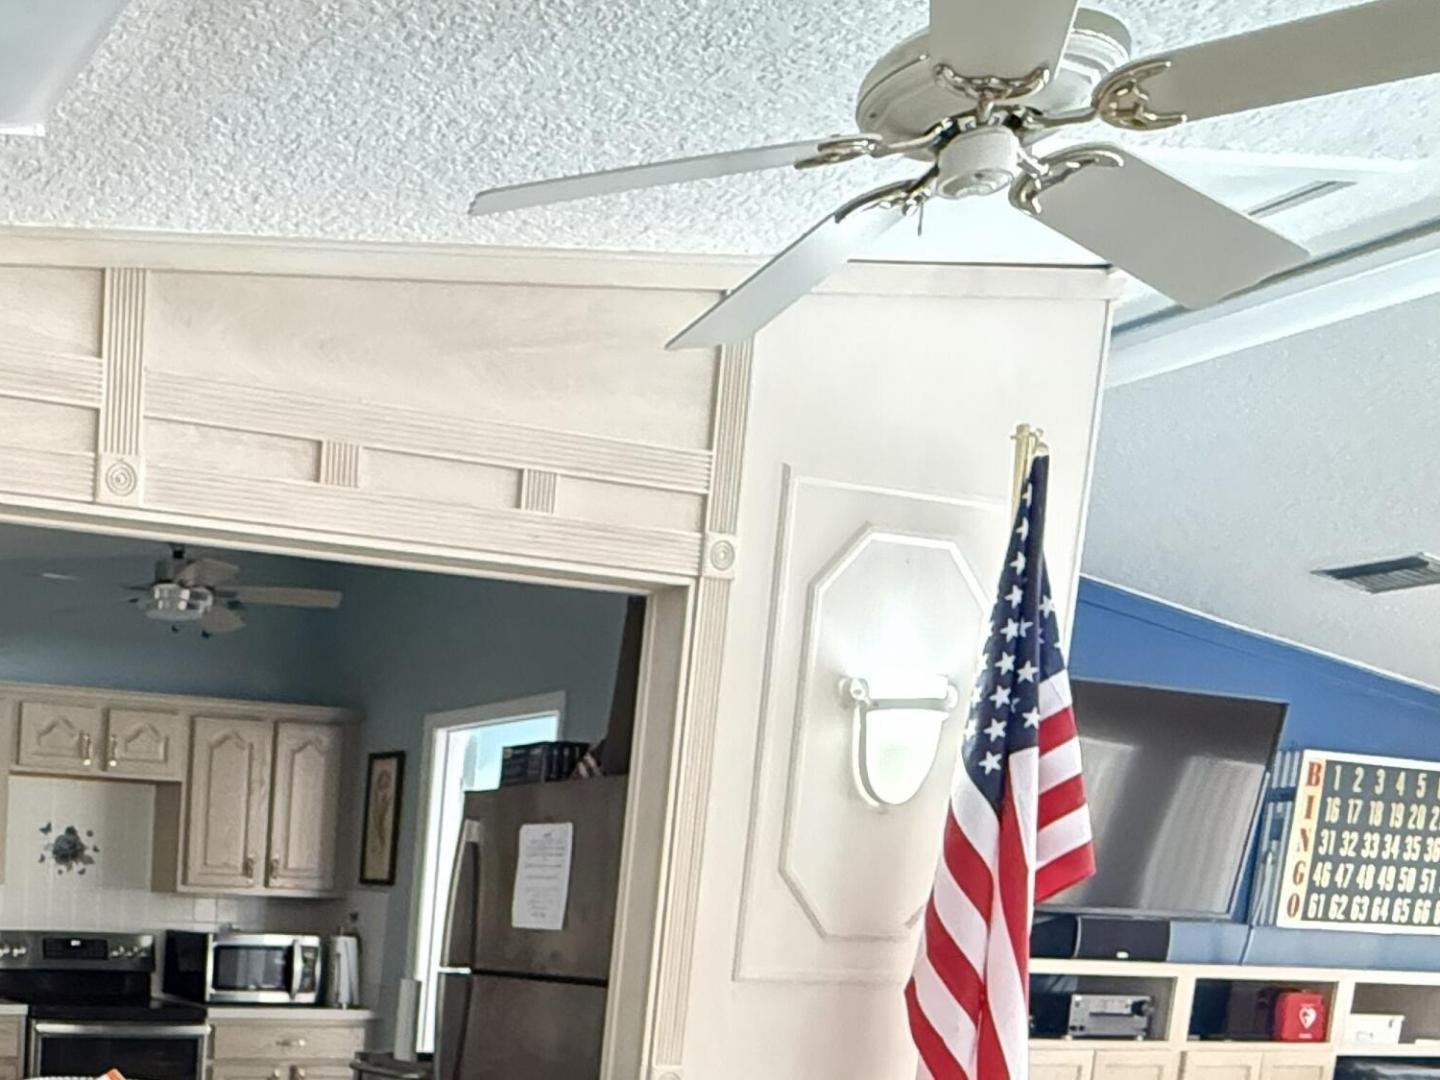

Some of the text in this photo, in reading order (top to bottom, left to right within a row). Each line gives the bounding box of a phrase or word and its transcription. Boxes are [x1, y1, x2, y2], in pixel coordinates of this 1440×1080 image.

[1334, 765, 1427, 798] 1 2 3 4 5
[1325, 797, 1440, 831] 16 17 18 19 20 2
[1318, 829, 1440, 862] 31 32 33 34 35 36
[1313, 862, 1436, 894] 46 47 48 49 50 51
[1307, 893, 1325, 918] 61
[1328, 894, 1348, 920] 62
[1350, 895, 1369, 921] 63
[1371, 897, 1390, 922] 64
[1392, 898, 1411, 923] 65
[1413, 899, 1432, 924] 66
